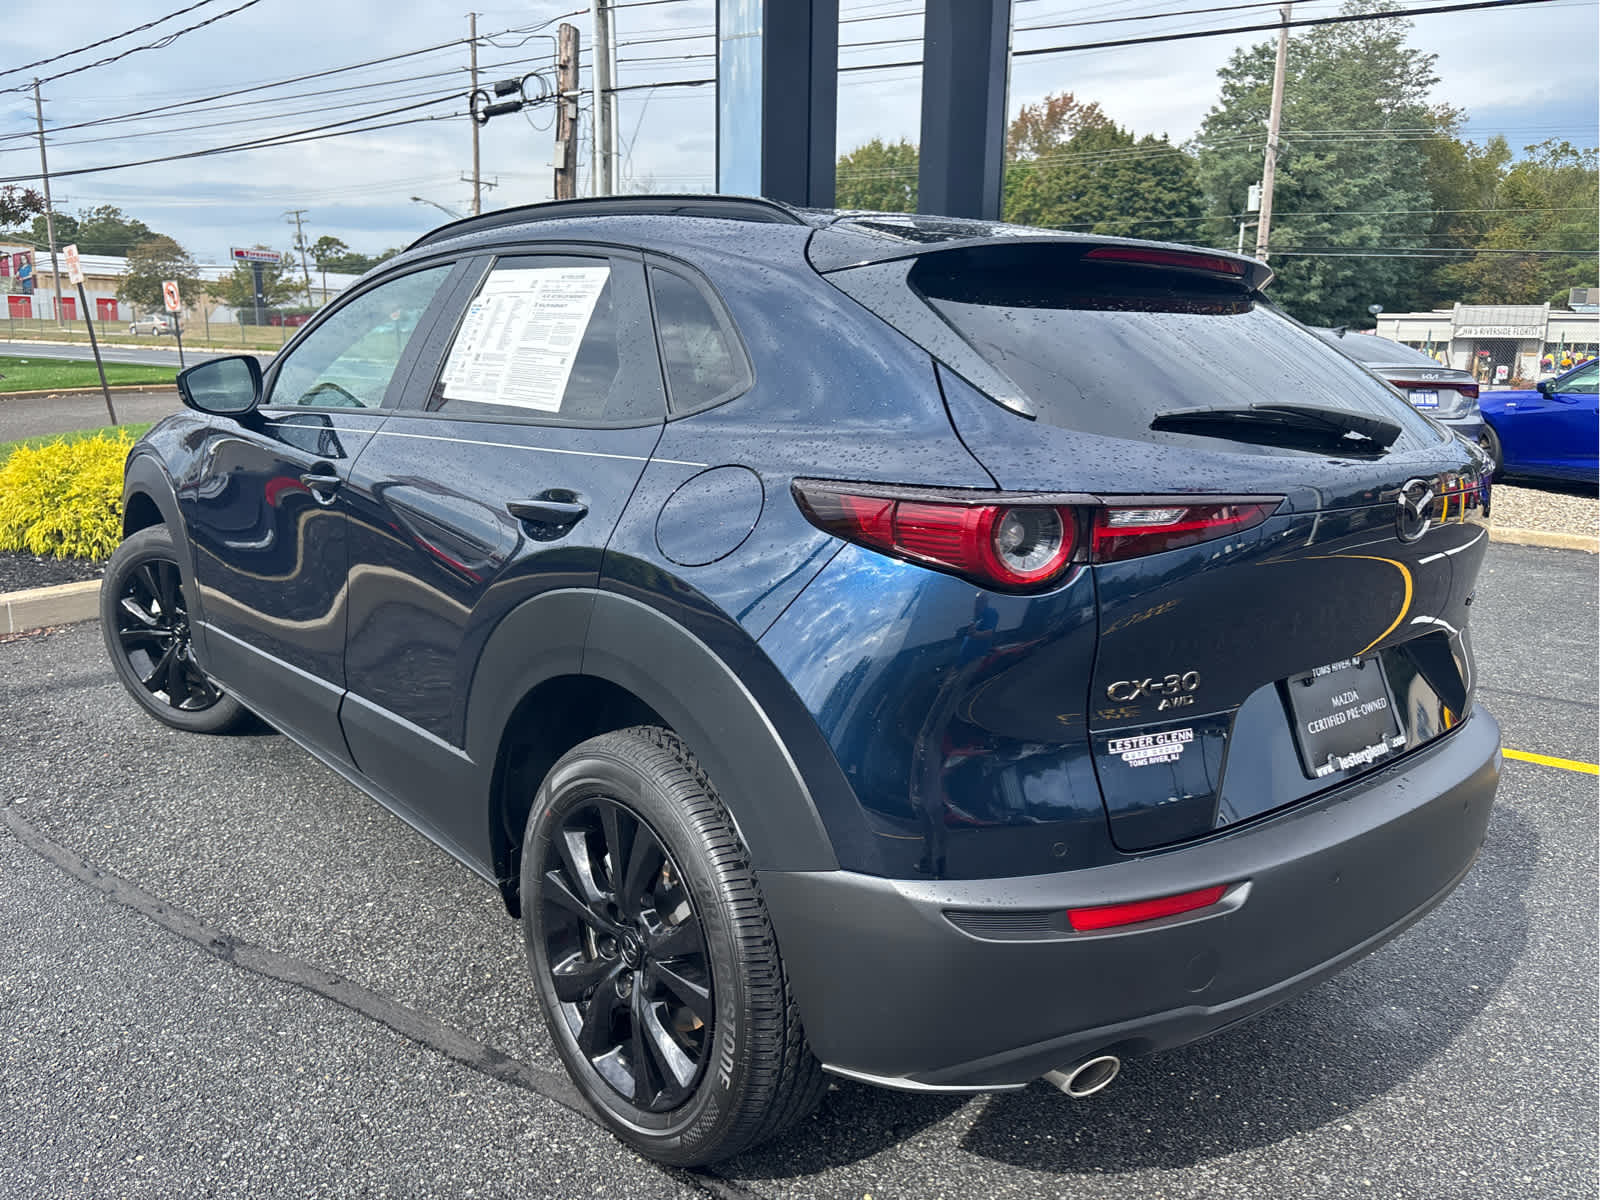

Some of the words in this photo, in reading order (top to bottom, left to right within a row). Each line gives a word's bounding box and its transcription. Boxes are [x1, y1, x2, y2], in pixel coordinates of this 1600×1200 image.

[1107, 671, 1200, 701] CX-30
[1158, 695, 1194, 711] AWD
[1331, 690, 1359, 707] MAZDA
[1308, 712, 1346, 734] CERTIFIED
[1346, 698, 1387, 720] PRE-OWNED
[1108, 737, 1153, 752] LESTER
[1156, 730, 1193, 745] GLENN
[1129, 758, 1148, 767] TOMS
